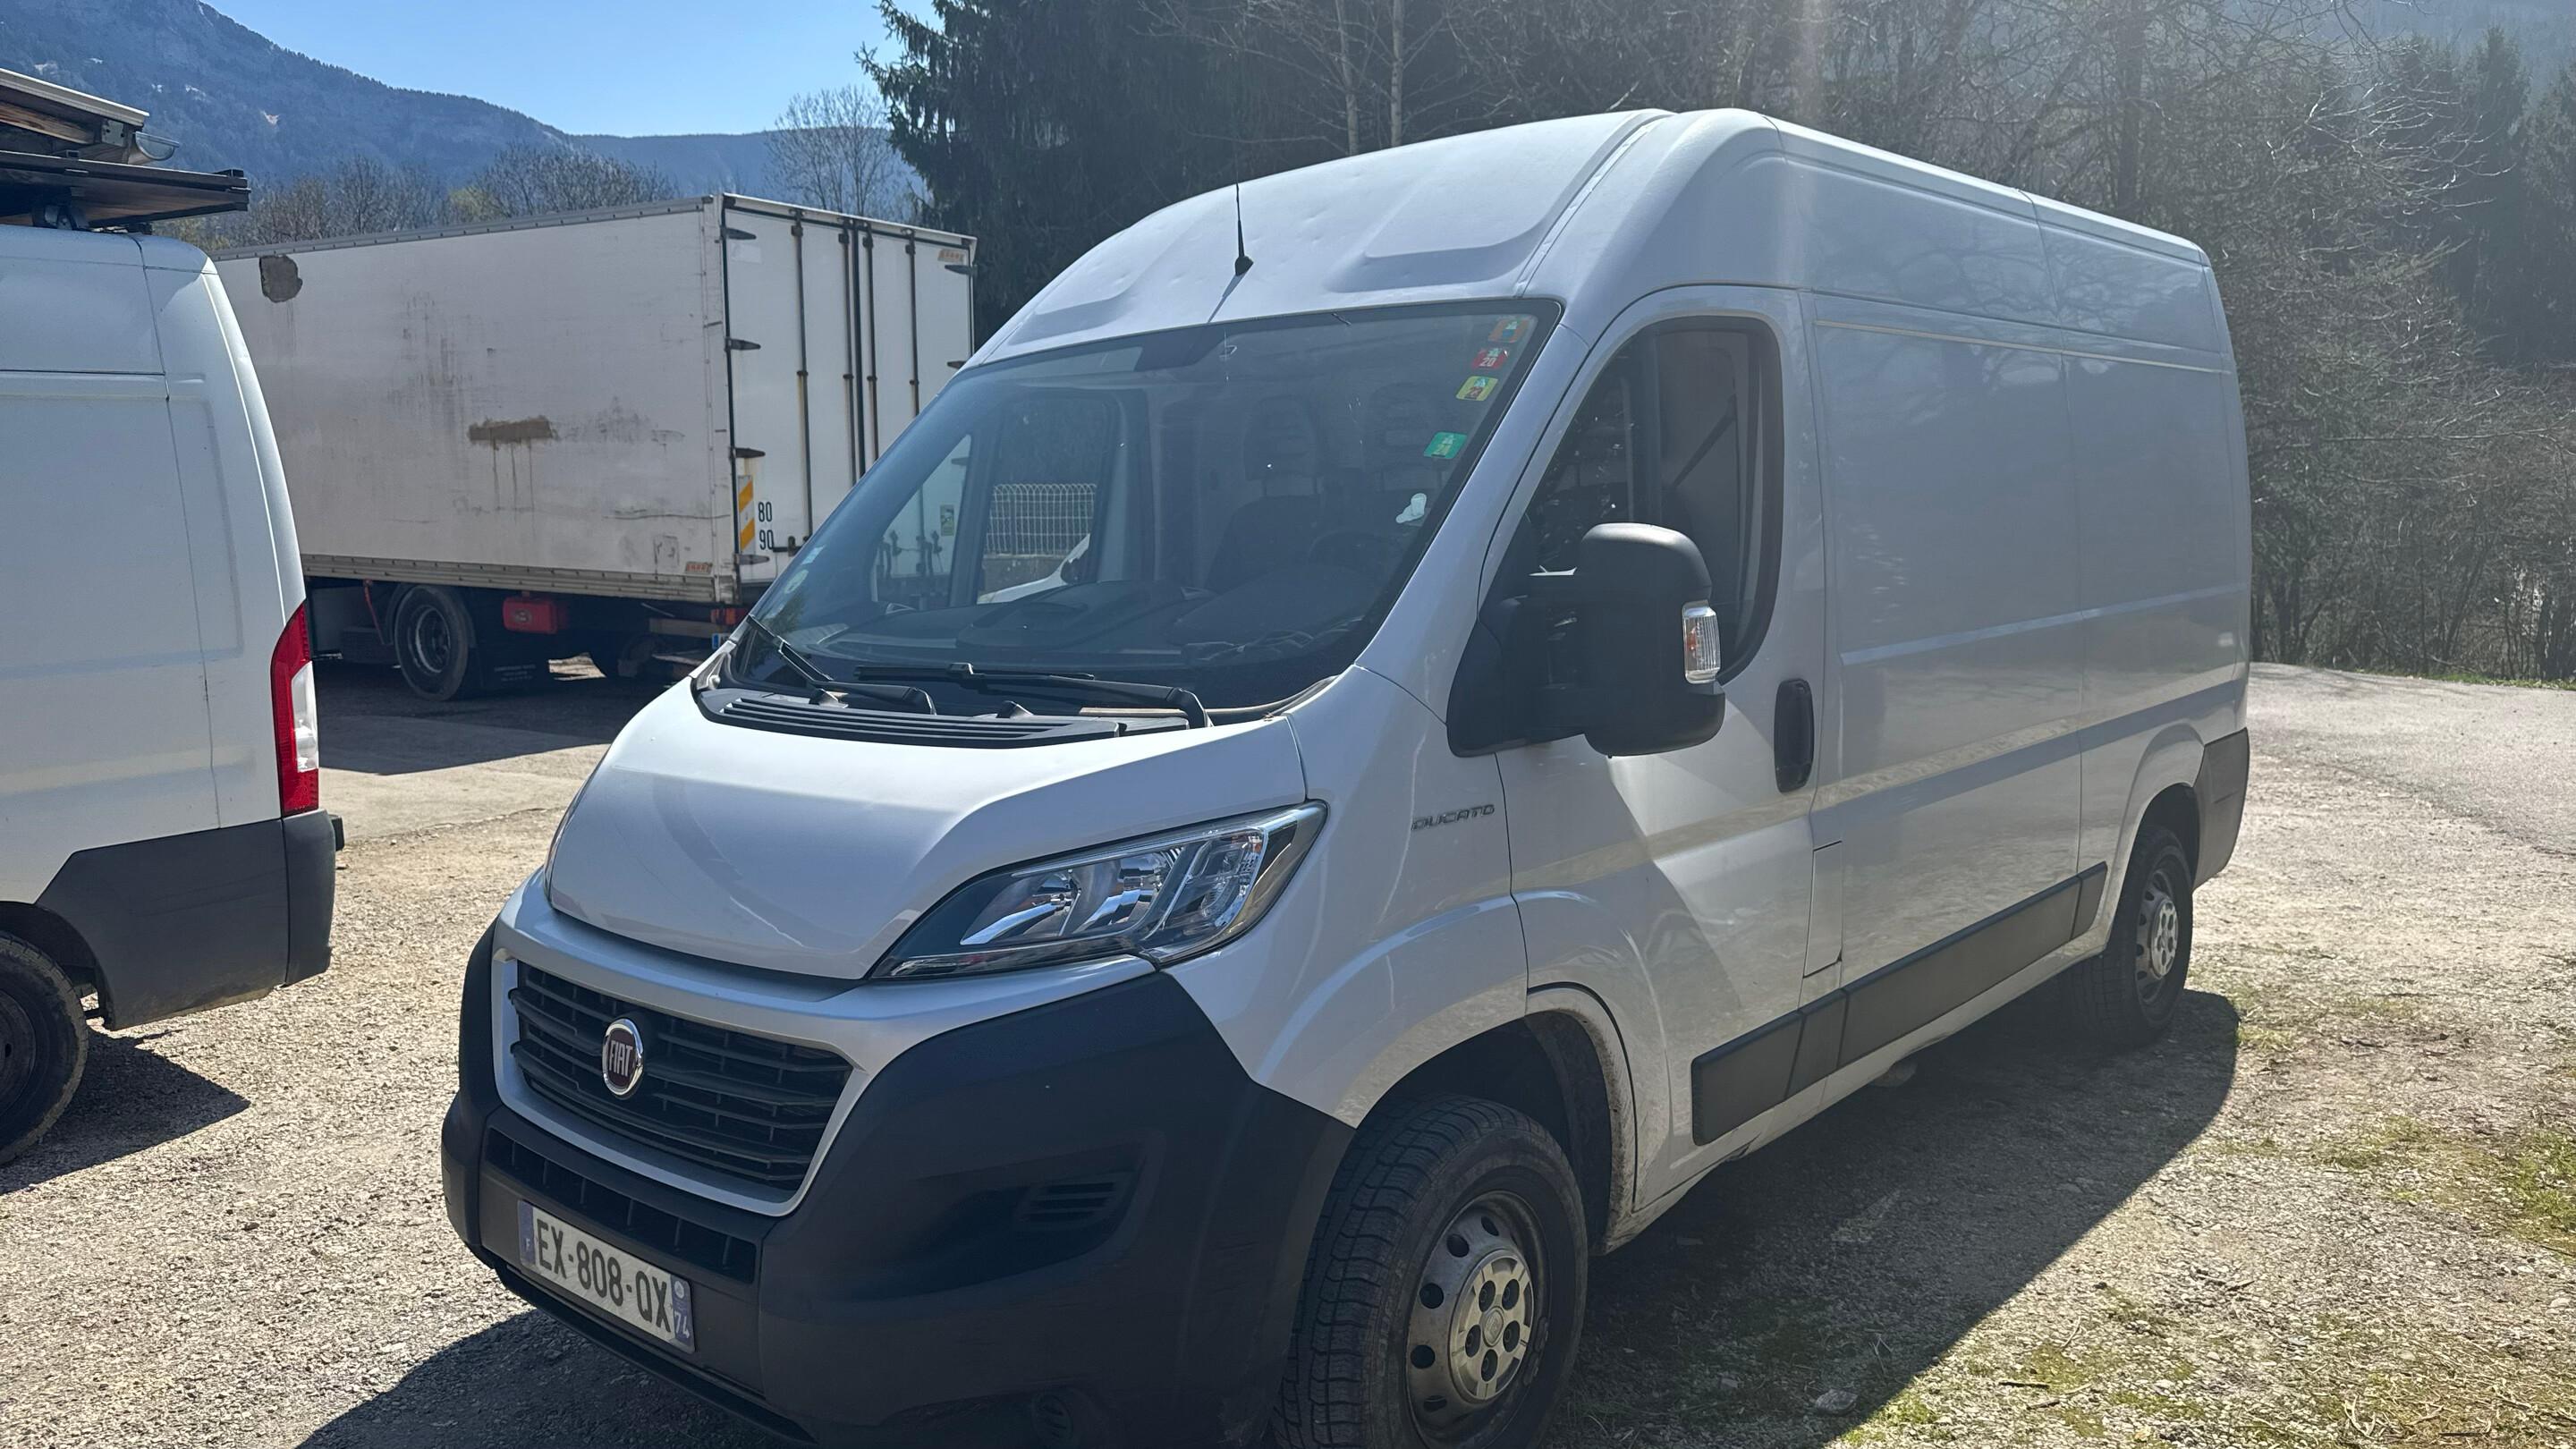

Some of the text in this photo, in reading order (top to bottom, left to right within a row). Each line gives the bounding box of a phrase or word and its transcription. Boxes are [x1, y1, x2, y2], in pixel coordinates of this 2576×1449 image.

[758, 501, 773, 522] 80
[758, 530, 775, 550] 90
[1411, 804, 1495, 830] DUCATO
[609, 1039, 633, 1077] FIAT
[537, 1218, 672, 1333] EX-808-QX
[674, 1310, 691, 1339] 74
